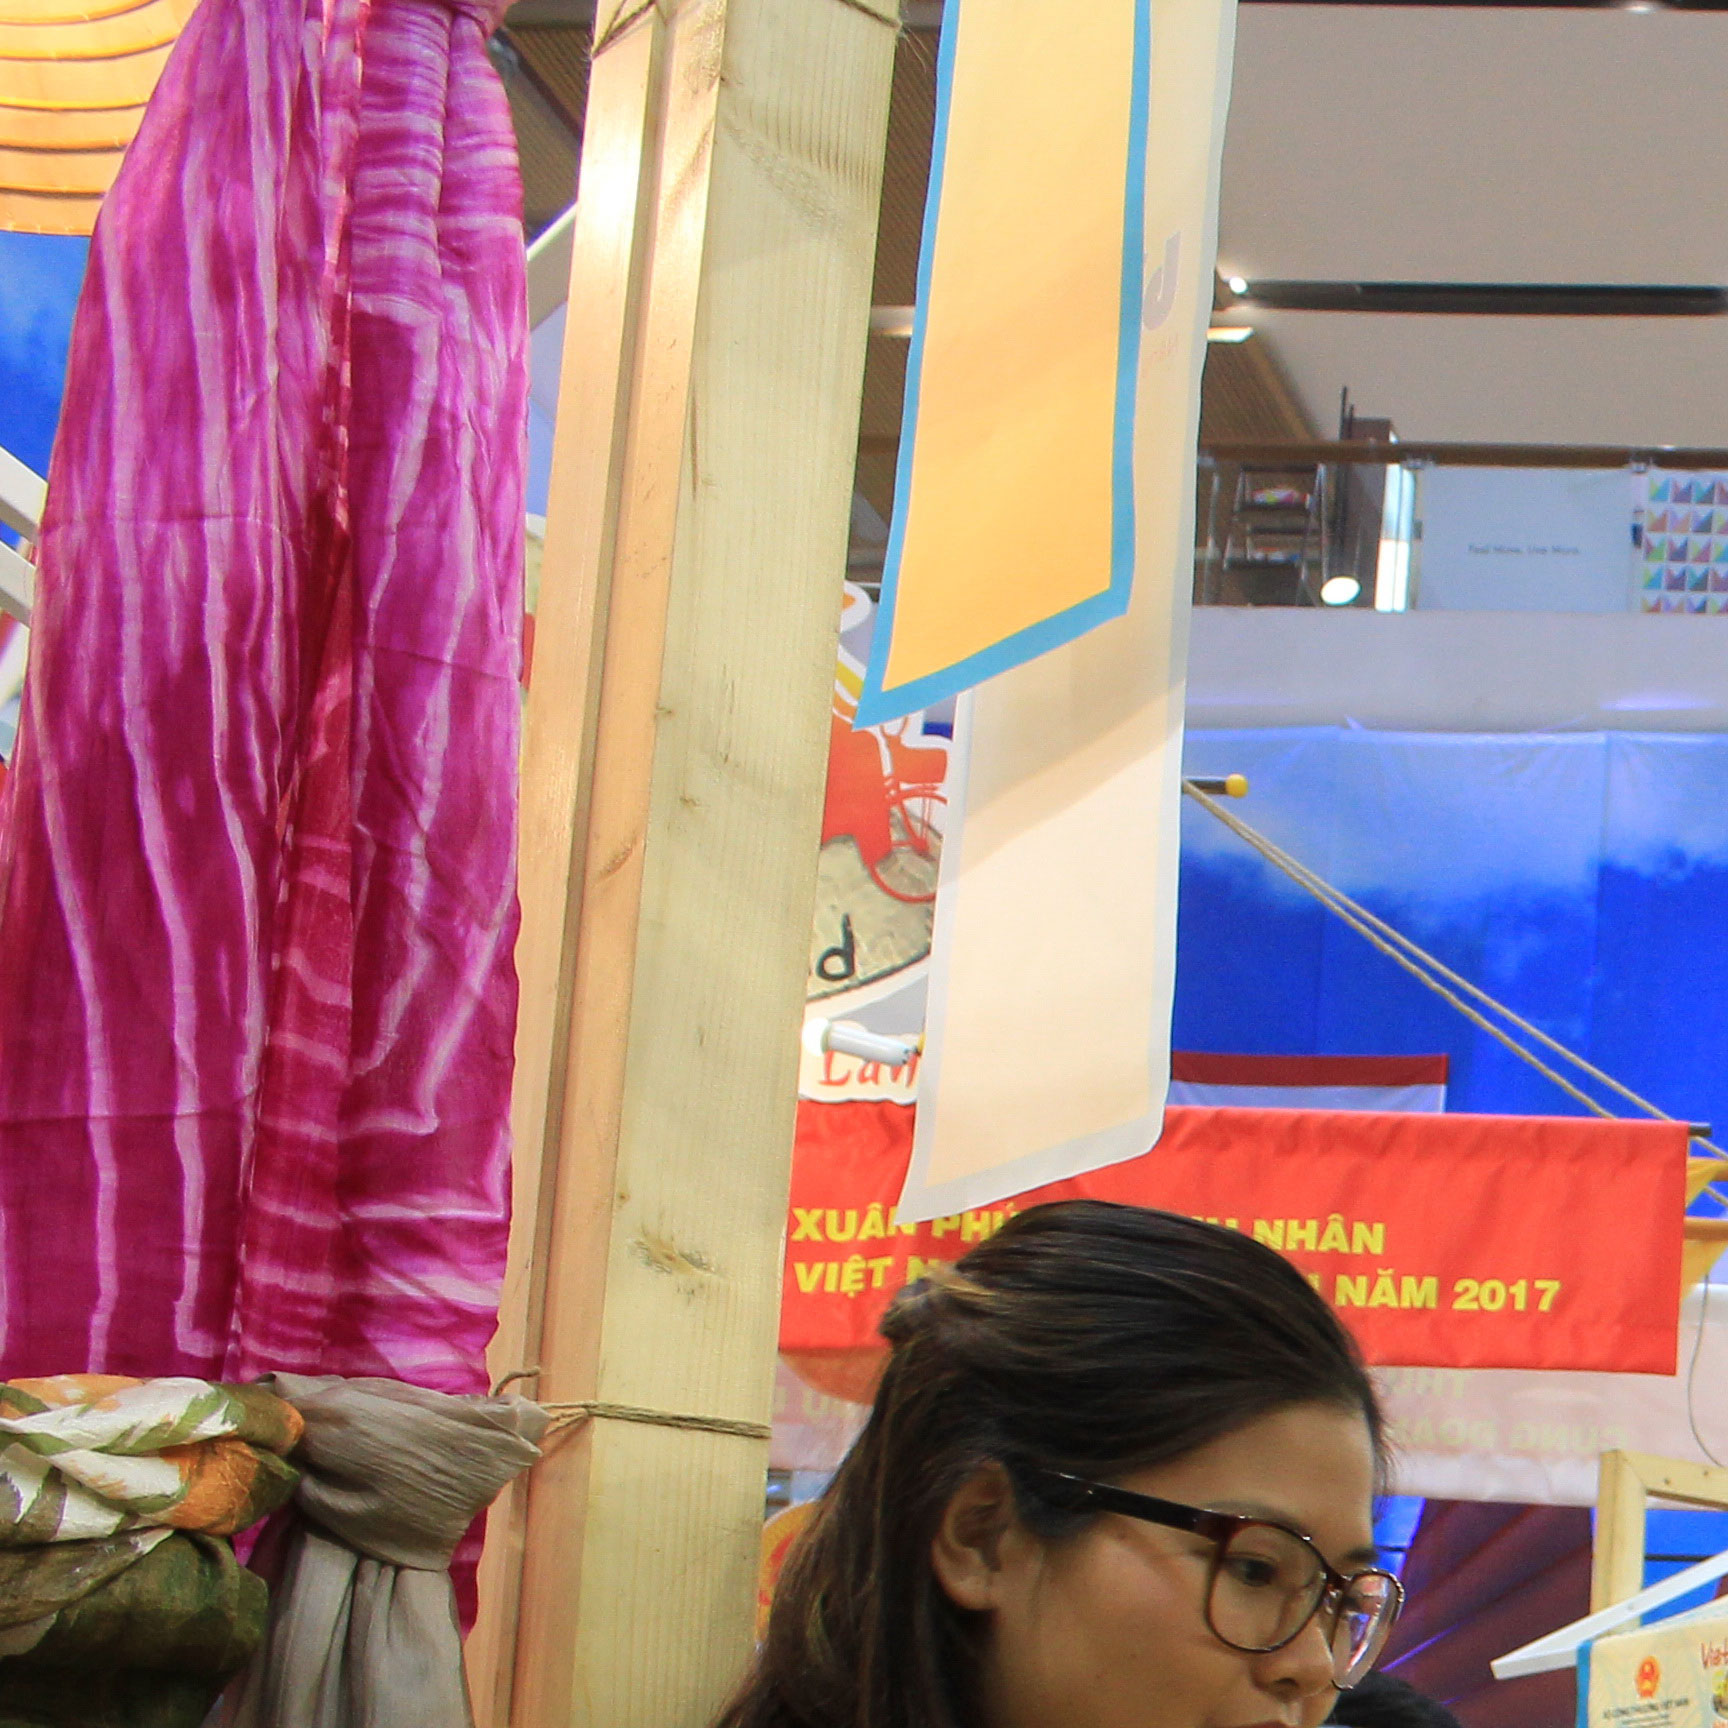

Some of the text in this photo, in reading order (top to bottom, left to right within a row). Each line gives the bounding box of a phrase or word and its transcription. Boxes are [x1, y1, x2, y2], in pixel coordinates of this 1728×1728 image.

[1253, 1213, 1386, 1255] NHÂN
[793, 1253, 895, 1298] VIỆT
[1335, 1267, 1440, 1309] NĂM
[1451, 1278, 1562, 1312] 2017
